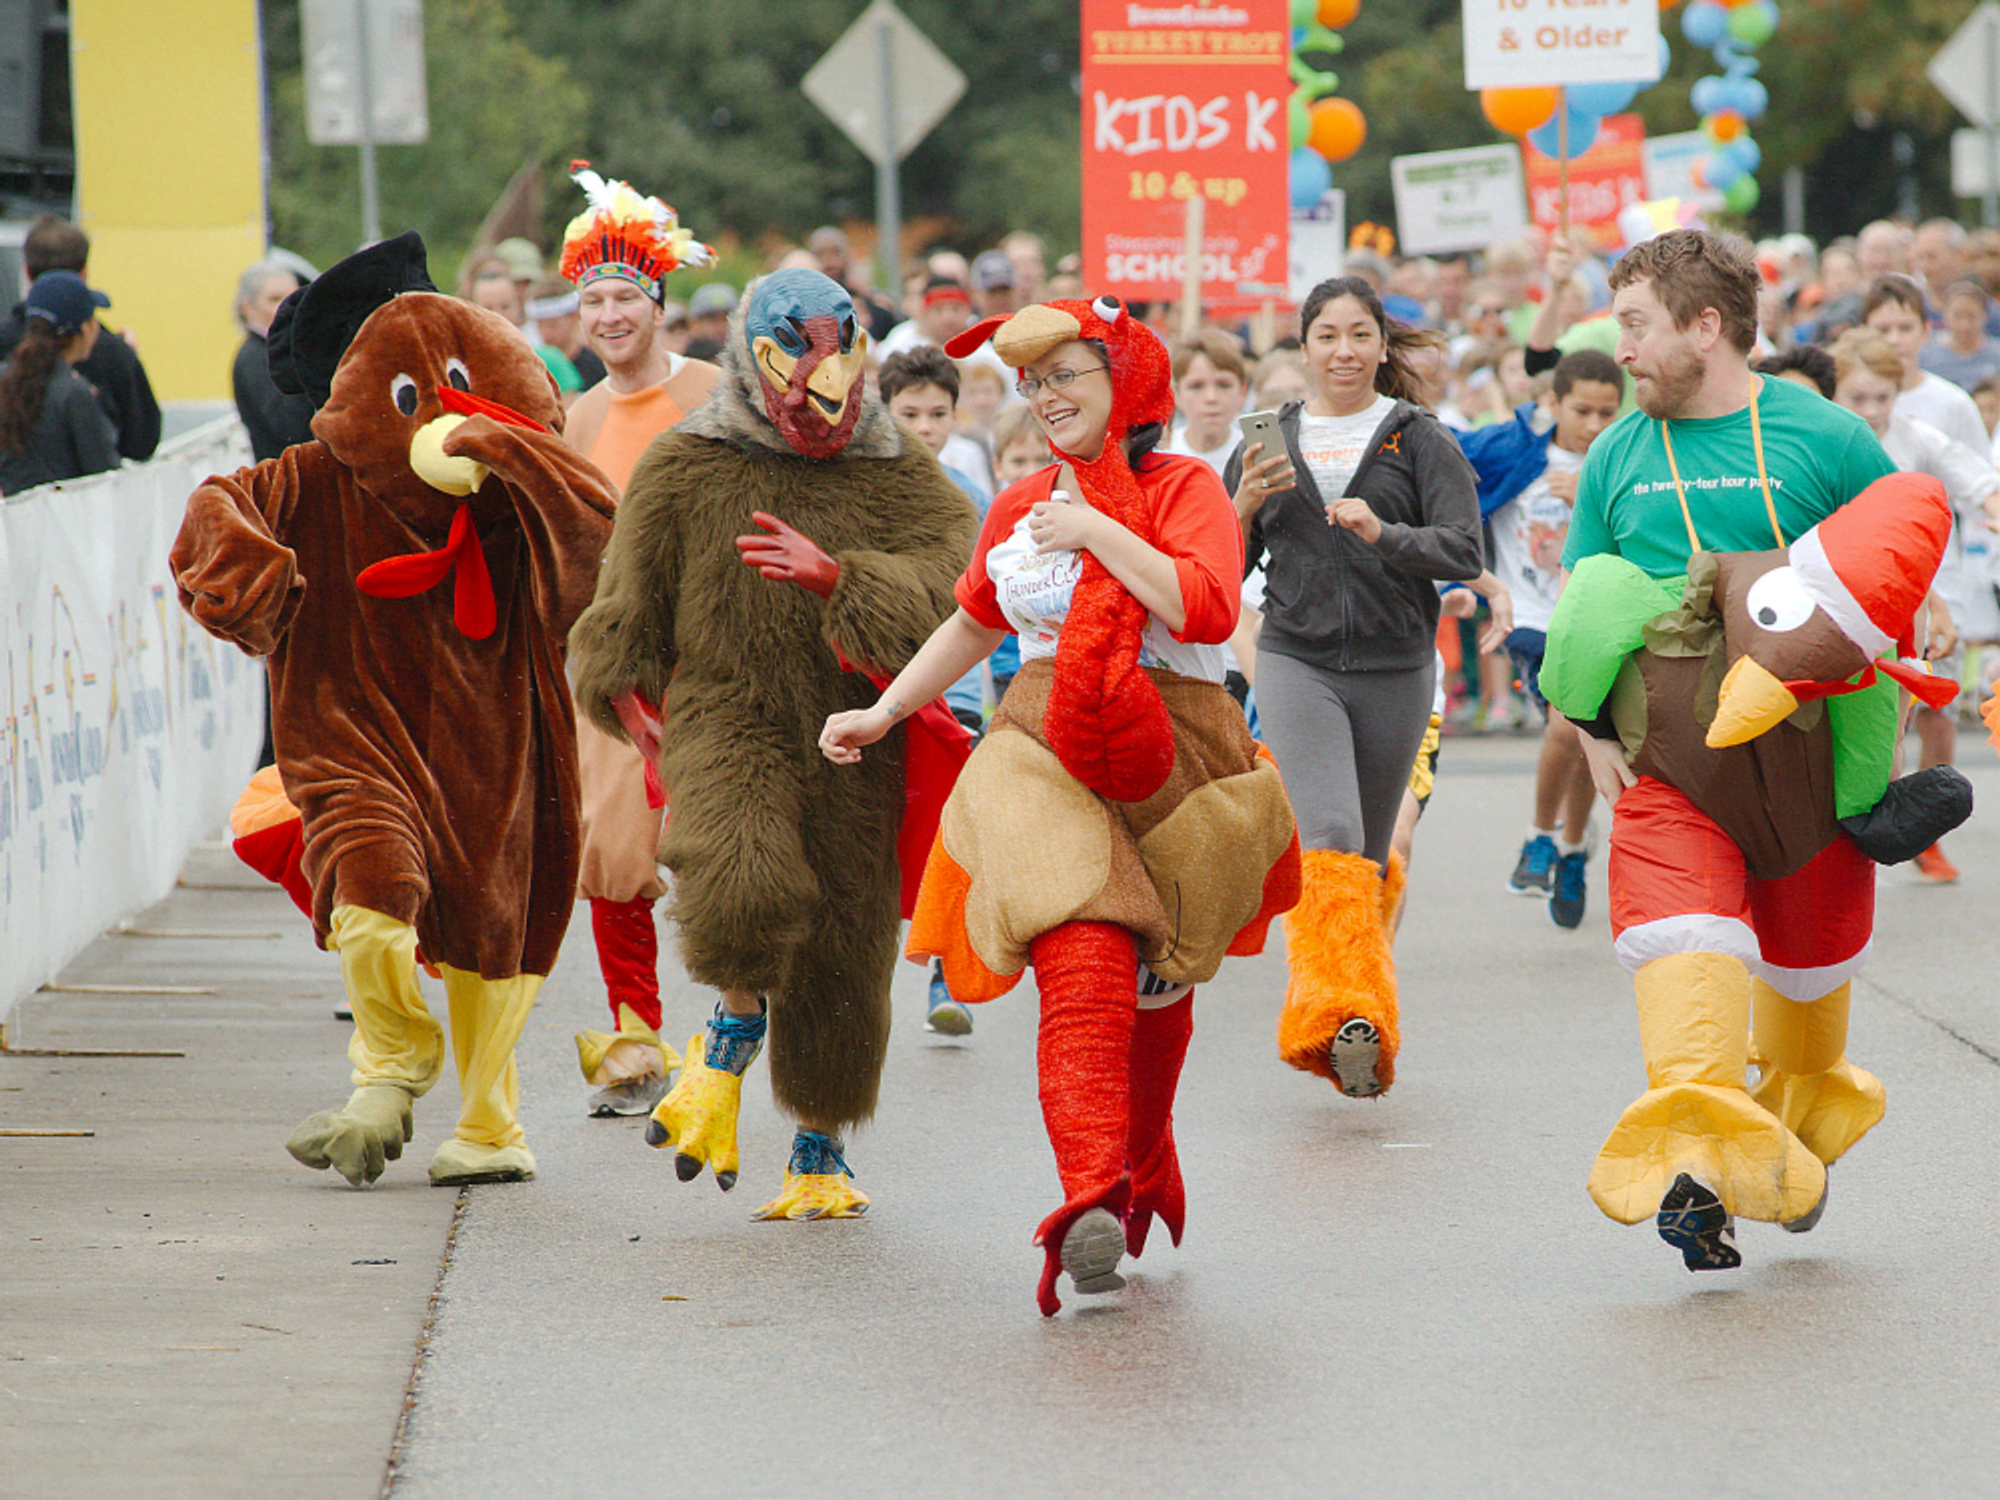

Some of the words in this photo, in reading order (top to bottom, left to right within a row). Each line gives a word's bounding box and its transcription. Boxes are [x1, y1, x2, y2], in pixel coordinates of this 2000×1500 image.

[1498, 26, 1520, 50] &
[1535, 25, 1629, 49] Older
[1094, 90, 1231, 156] KIDS
[1245, 90, 1278, 151] K
[1129, 171, 1166, 200] 10
[1171, 171, 1198, 200] &
[1204, 177, 1247, 206] up
[1634, 482, 1649, 495] the
[1721, 475, 1747, 487] hour
